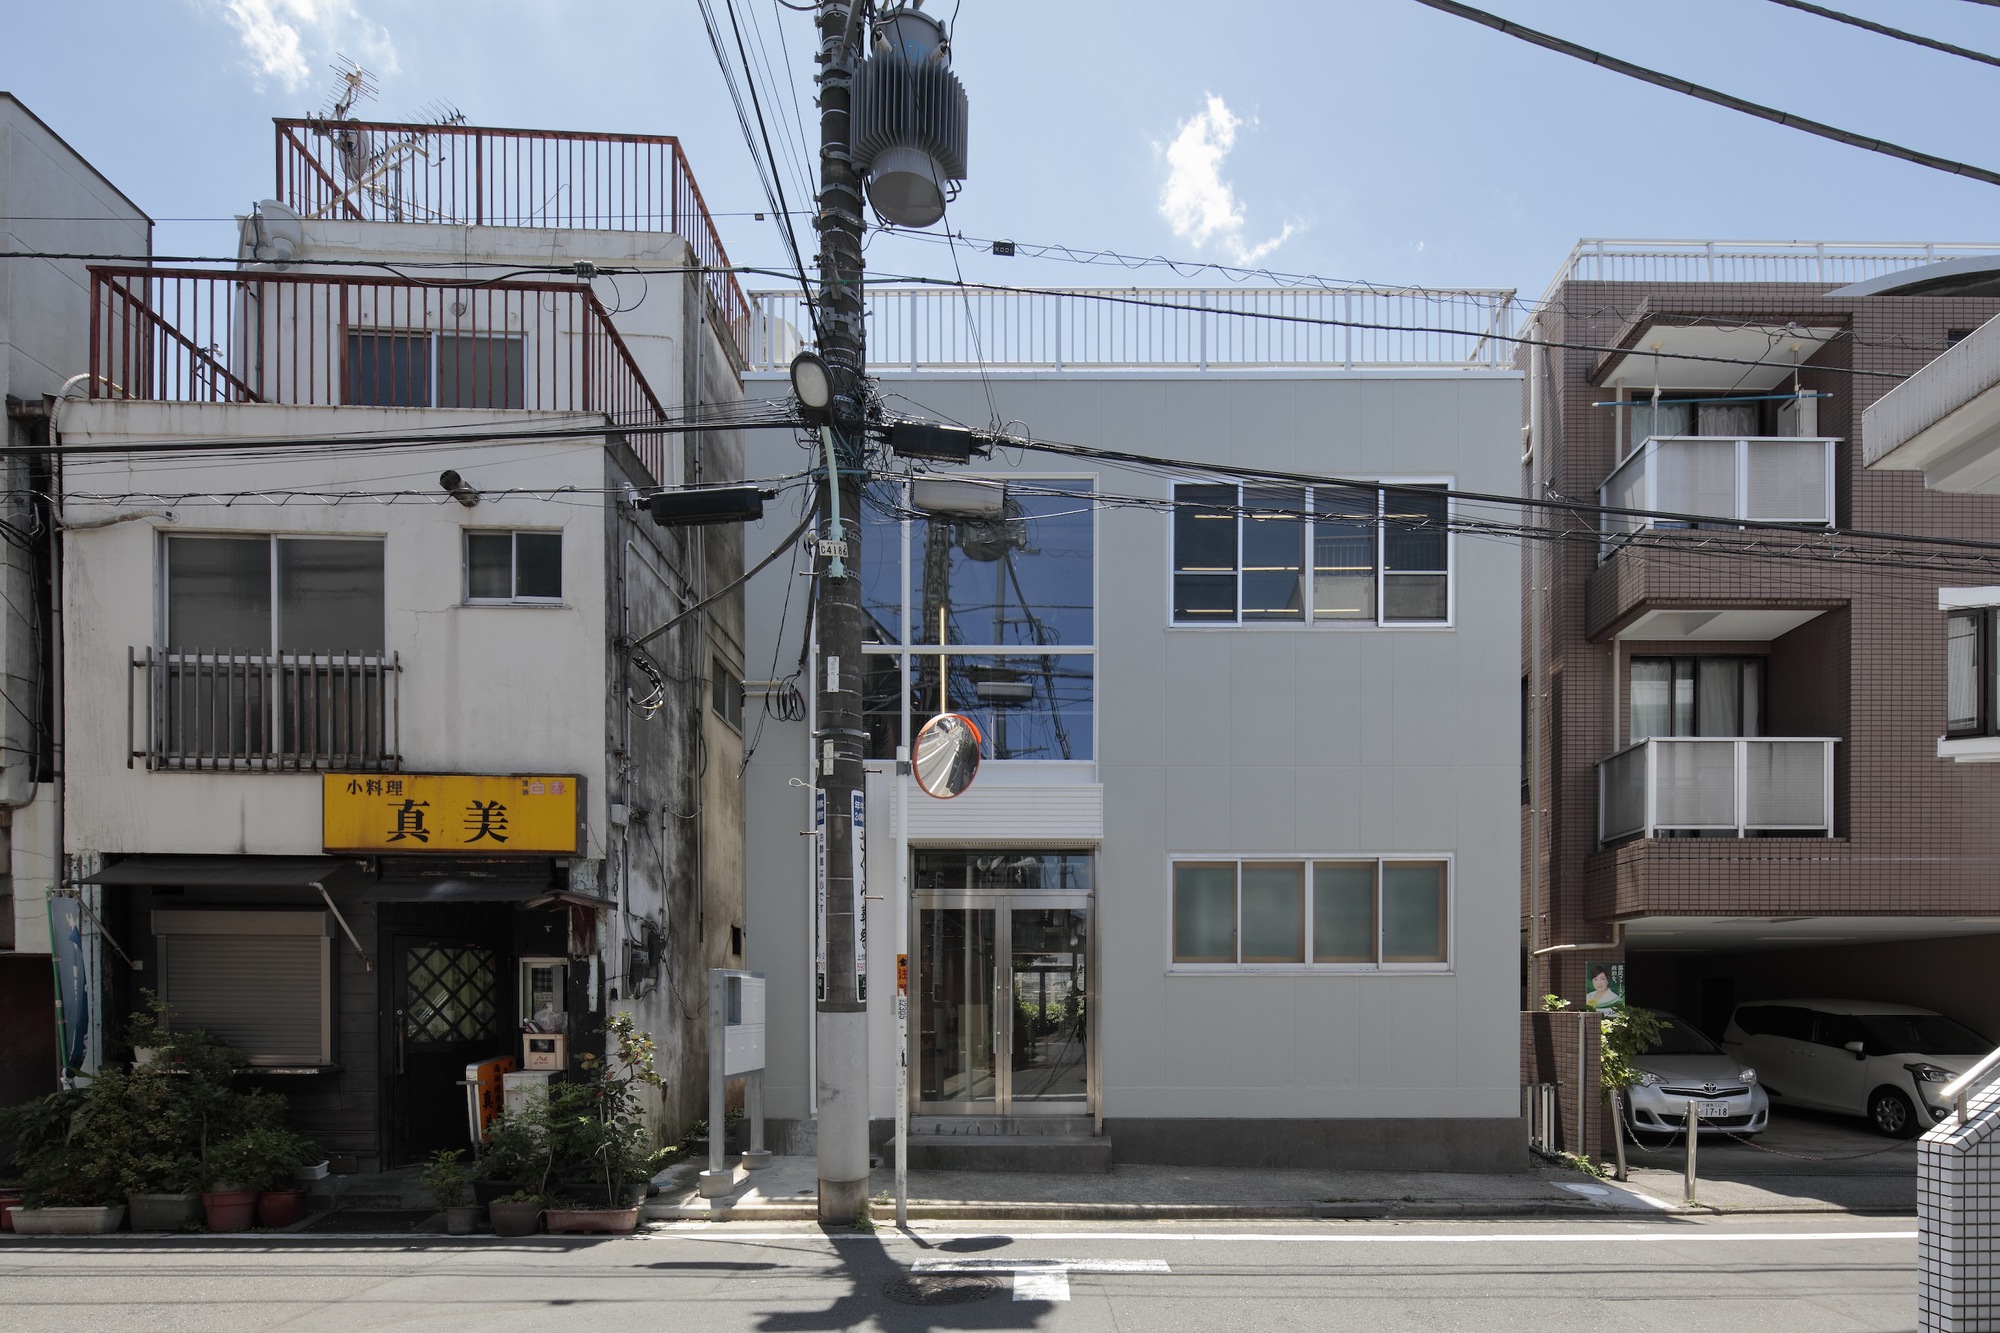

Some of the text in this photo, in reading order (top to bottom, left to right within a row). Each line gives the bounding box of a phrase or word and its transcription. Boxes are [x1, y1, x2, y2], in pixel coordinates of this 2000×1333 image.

[346, 779, 404, 797] 小料理
[385, 799, 509, 843] 真美
[1705, 1107, 1728, 1117] 17-18
